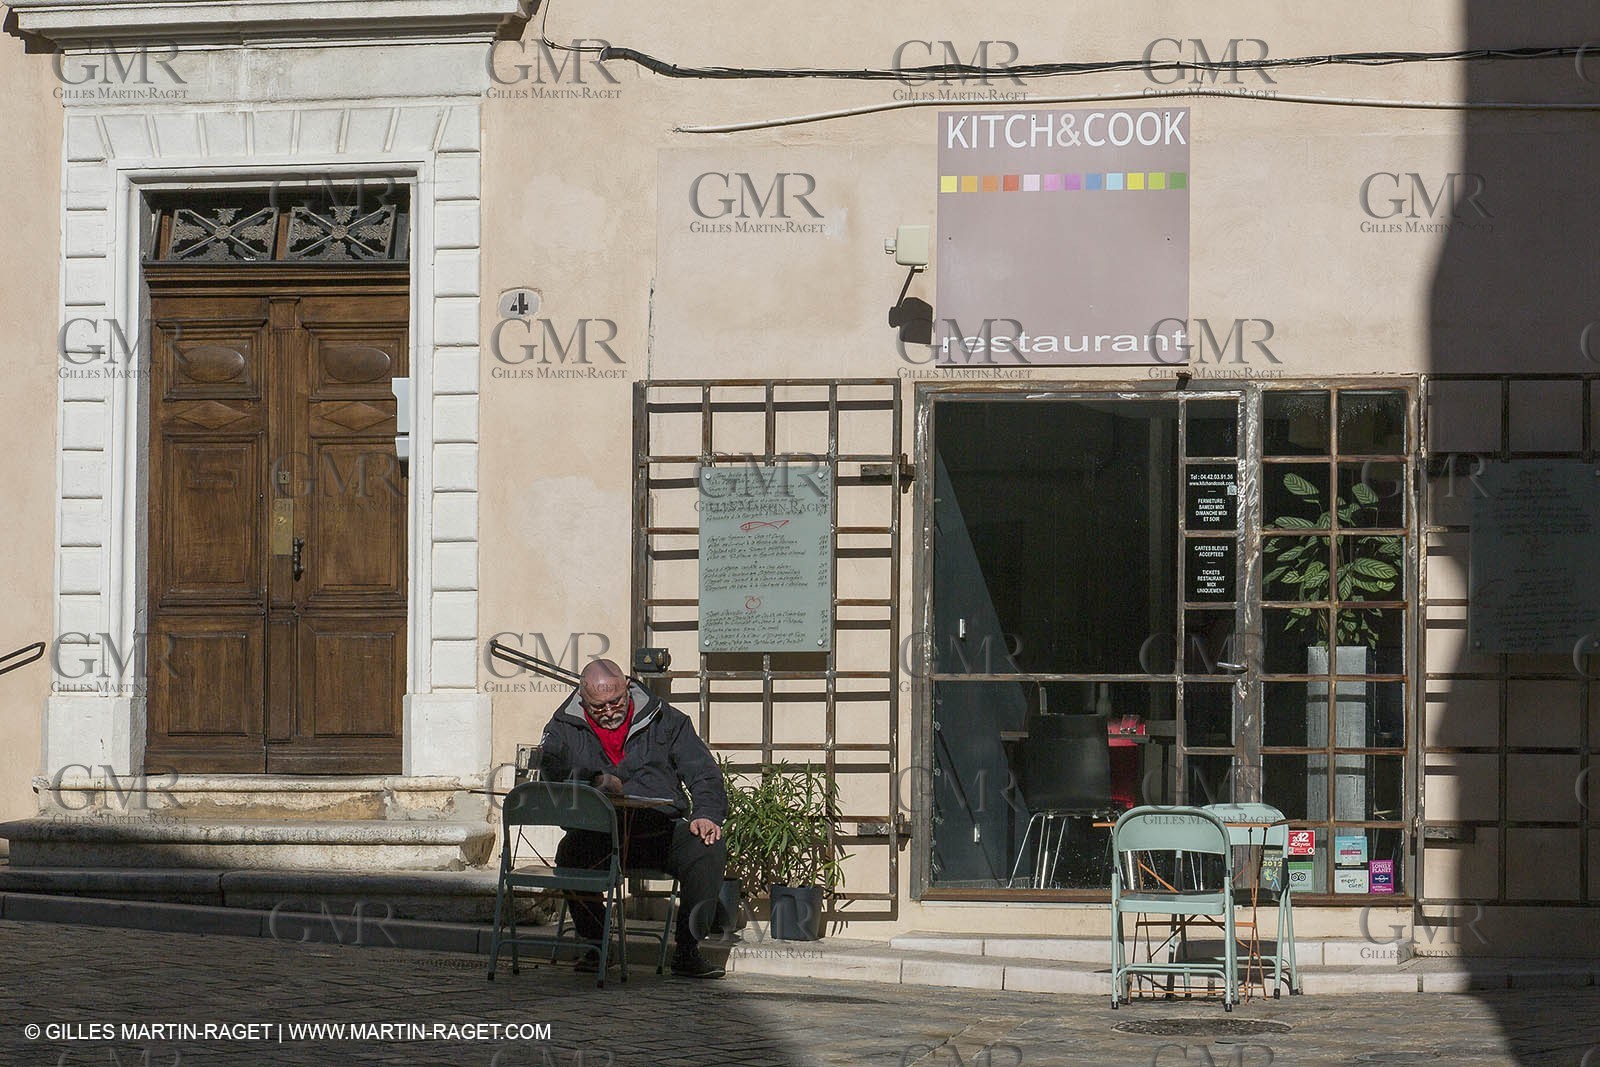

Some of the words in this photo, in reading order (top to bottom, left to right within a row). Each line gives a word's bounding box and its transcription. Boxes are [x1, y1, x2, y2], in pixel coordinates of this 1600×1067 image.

[947, 111, 1186, 149] KITCH&COOK
[510, 292, 528, 315] 4
[942, 330, 1186, 353] restaurant
